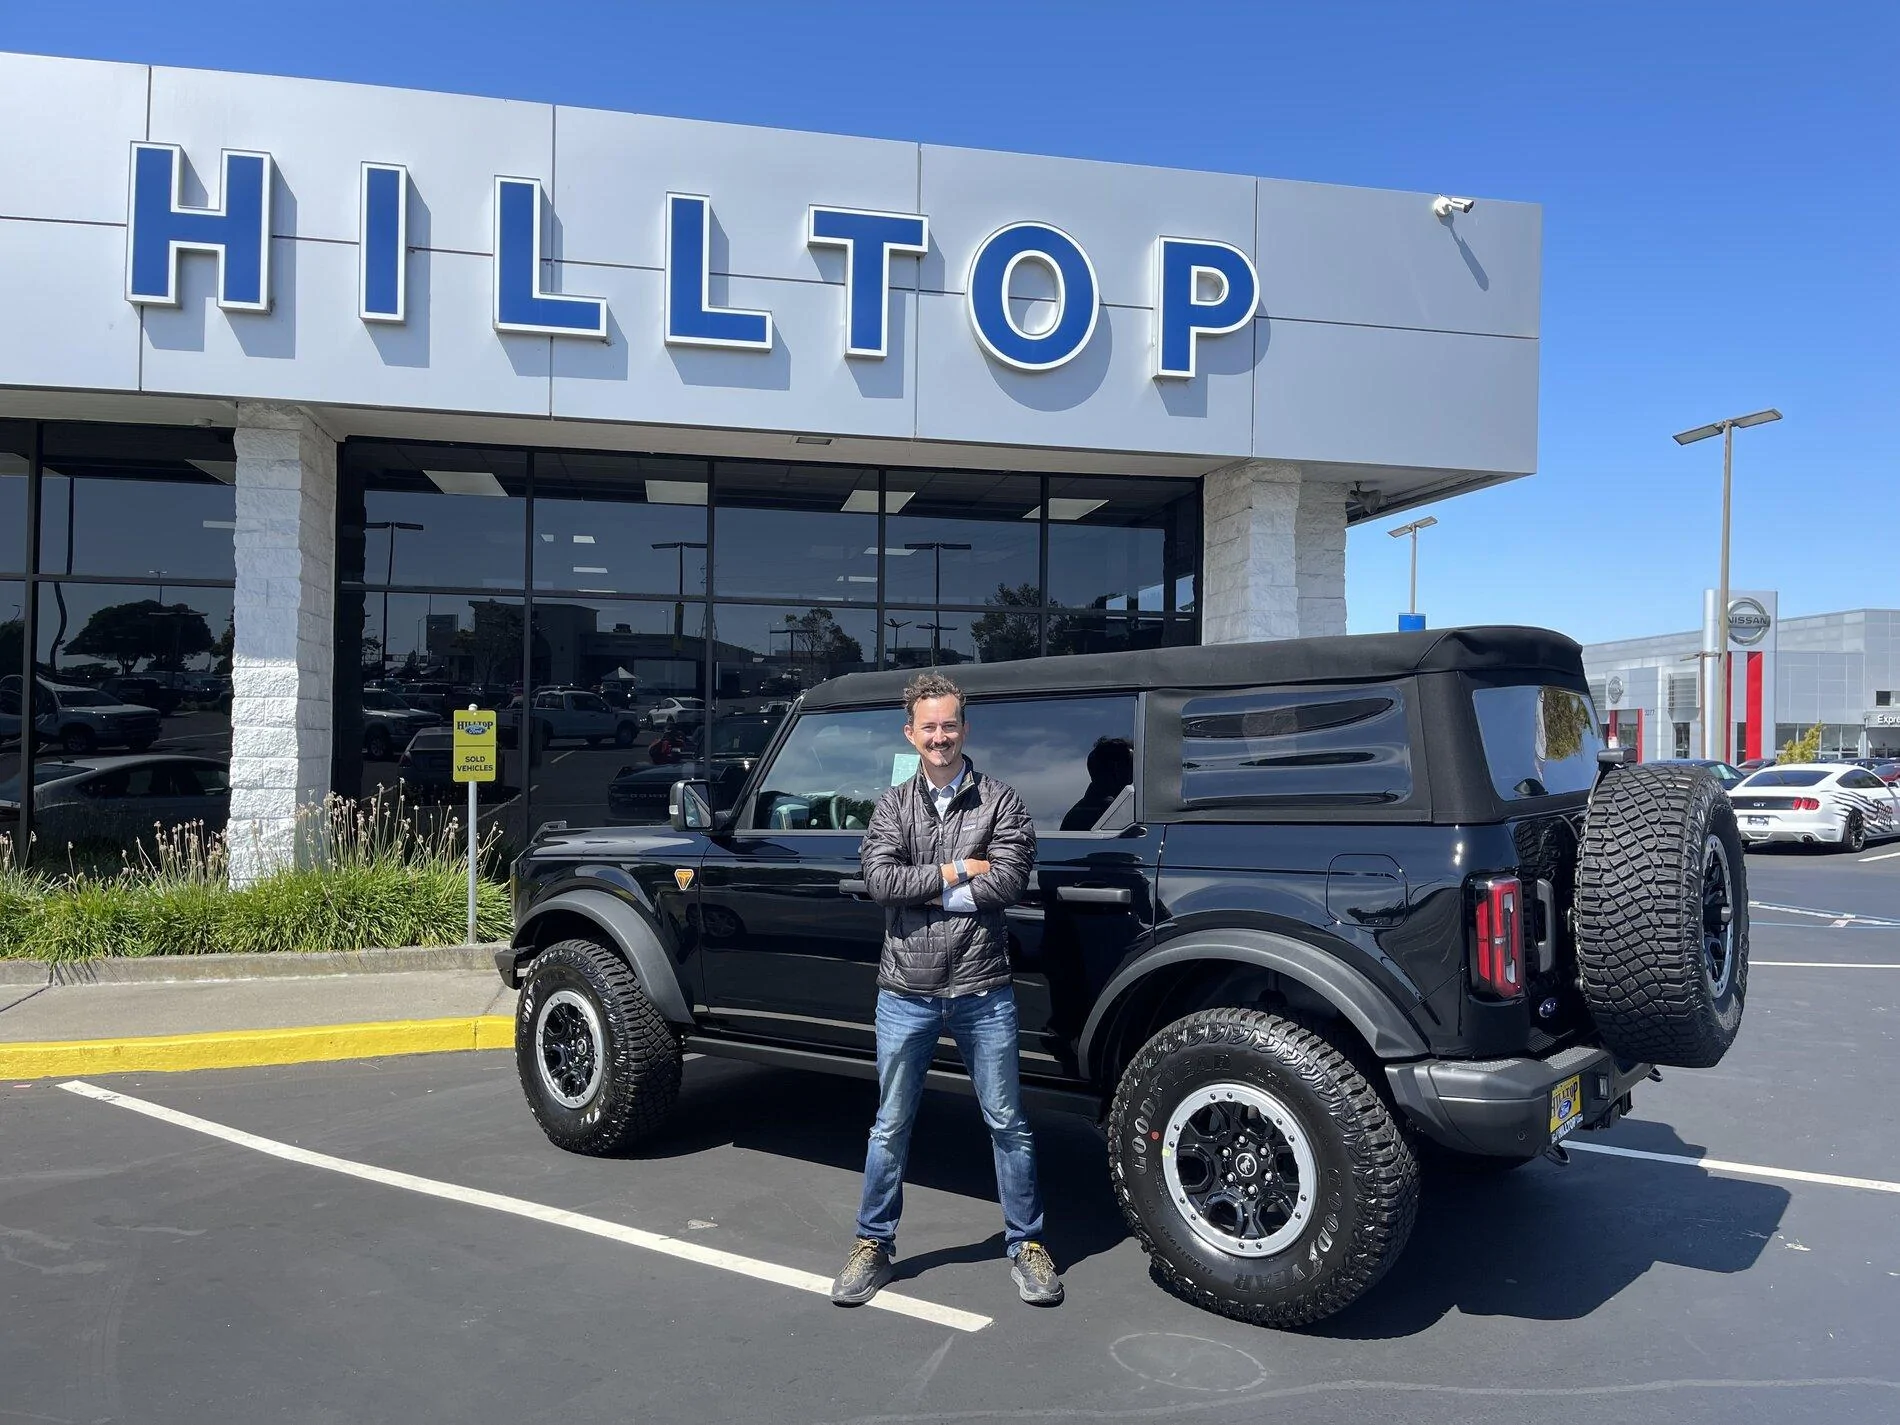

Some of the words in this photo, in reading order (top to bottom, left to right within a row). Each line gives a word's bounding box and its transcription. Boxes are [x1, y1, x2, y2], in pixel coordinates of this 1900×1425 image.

[126, 141, 1261, 379] HILLTOP
[1728, 616, 1767, 625] NISSAN
[456, 721, 493, 730] HILLTOP
[1551, 1081, 1578, 1117] HILLTOP
